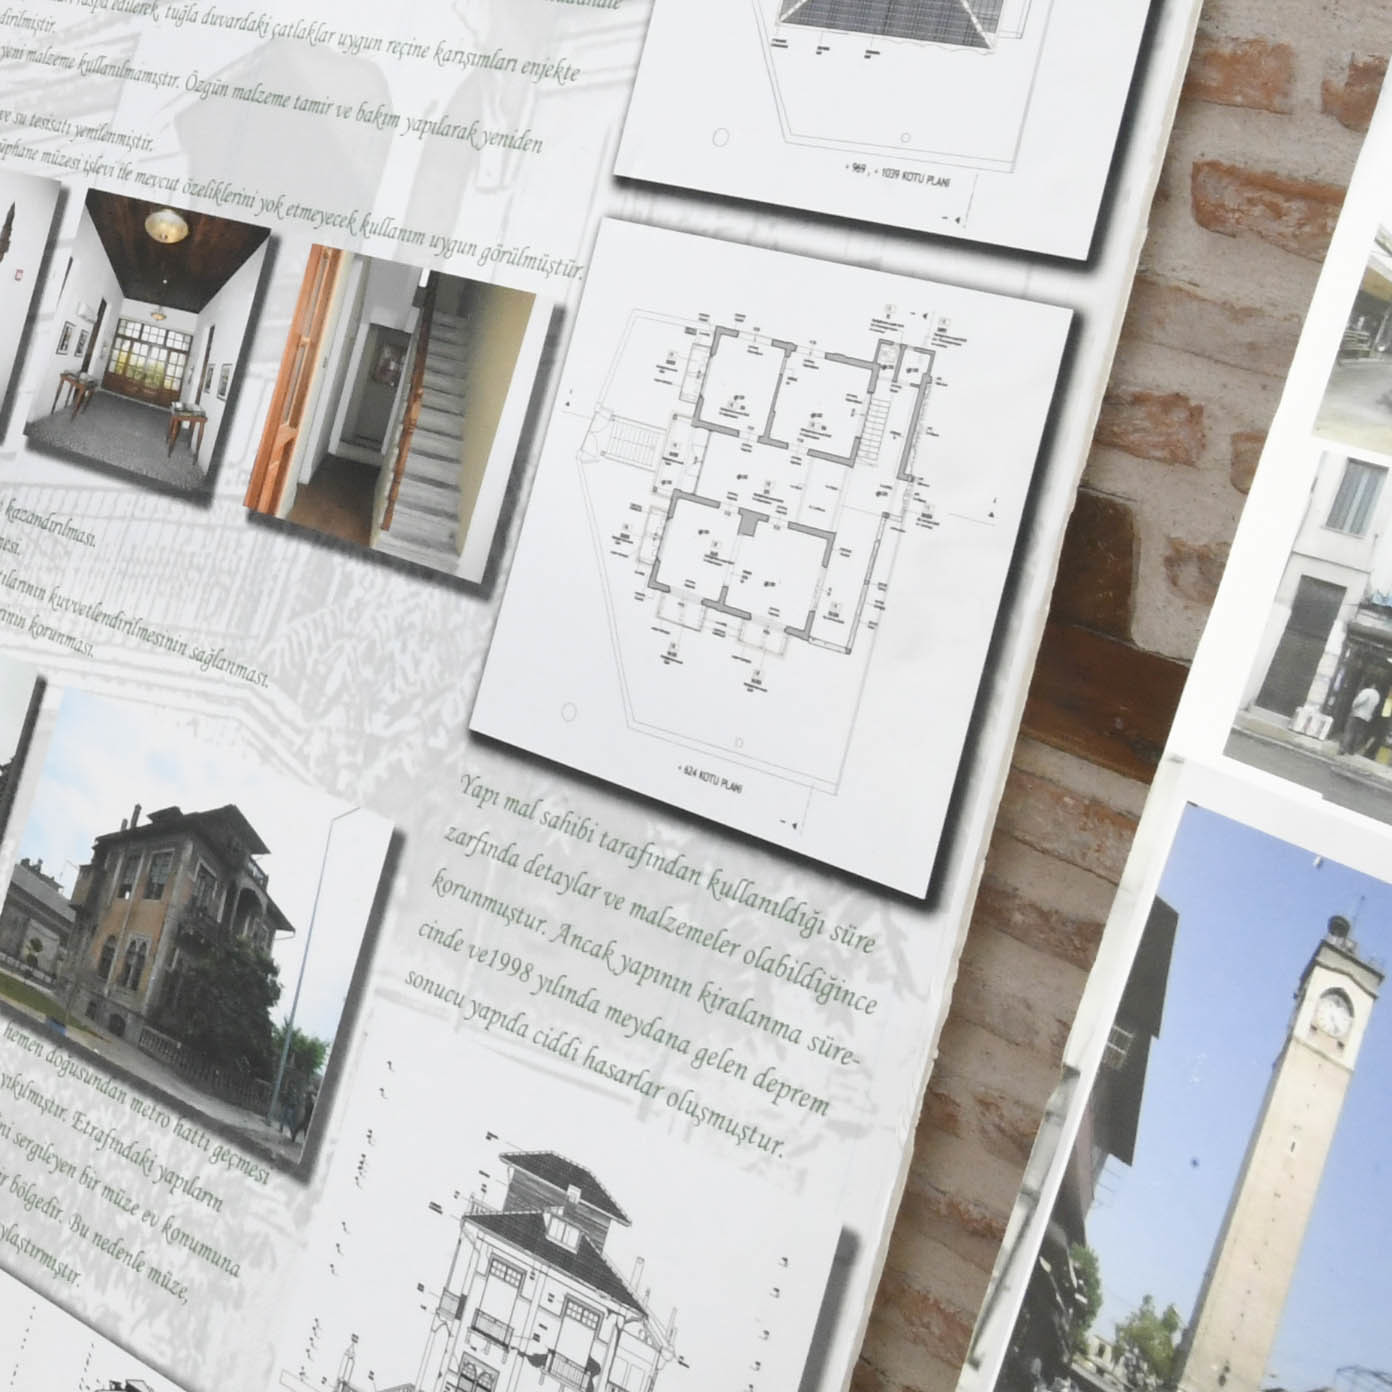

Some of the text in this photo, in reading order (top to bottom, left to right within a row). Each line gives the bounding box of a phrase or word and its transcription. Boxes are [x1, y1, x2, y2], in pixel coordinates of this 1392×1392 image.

[431, 868, 545, 933] korunmuştur.
[550, 915, 615, 966] Ancak
[614, 949, 692, 992] yapının
[697, 973, 801, 1040] kiralanma
[444, 828, 877, 1015] zarfında detaylar ve malzemeler olabildiğince
[459, 772, 875, 953] Yapı mal sahibi tarafından kullanıldığı süre
[405, 970, 782, 1157] sonucu yapıda ciddi hasarlar oluşmuştur.
[418, 922, 464, 953] cinde
[531, 969, 600, 1012] yılında
[605, 1002, 689, 1051] meydana
[691, 1040, 747, 1078] gelen
[753, 1060, 828, 1115] deprem
